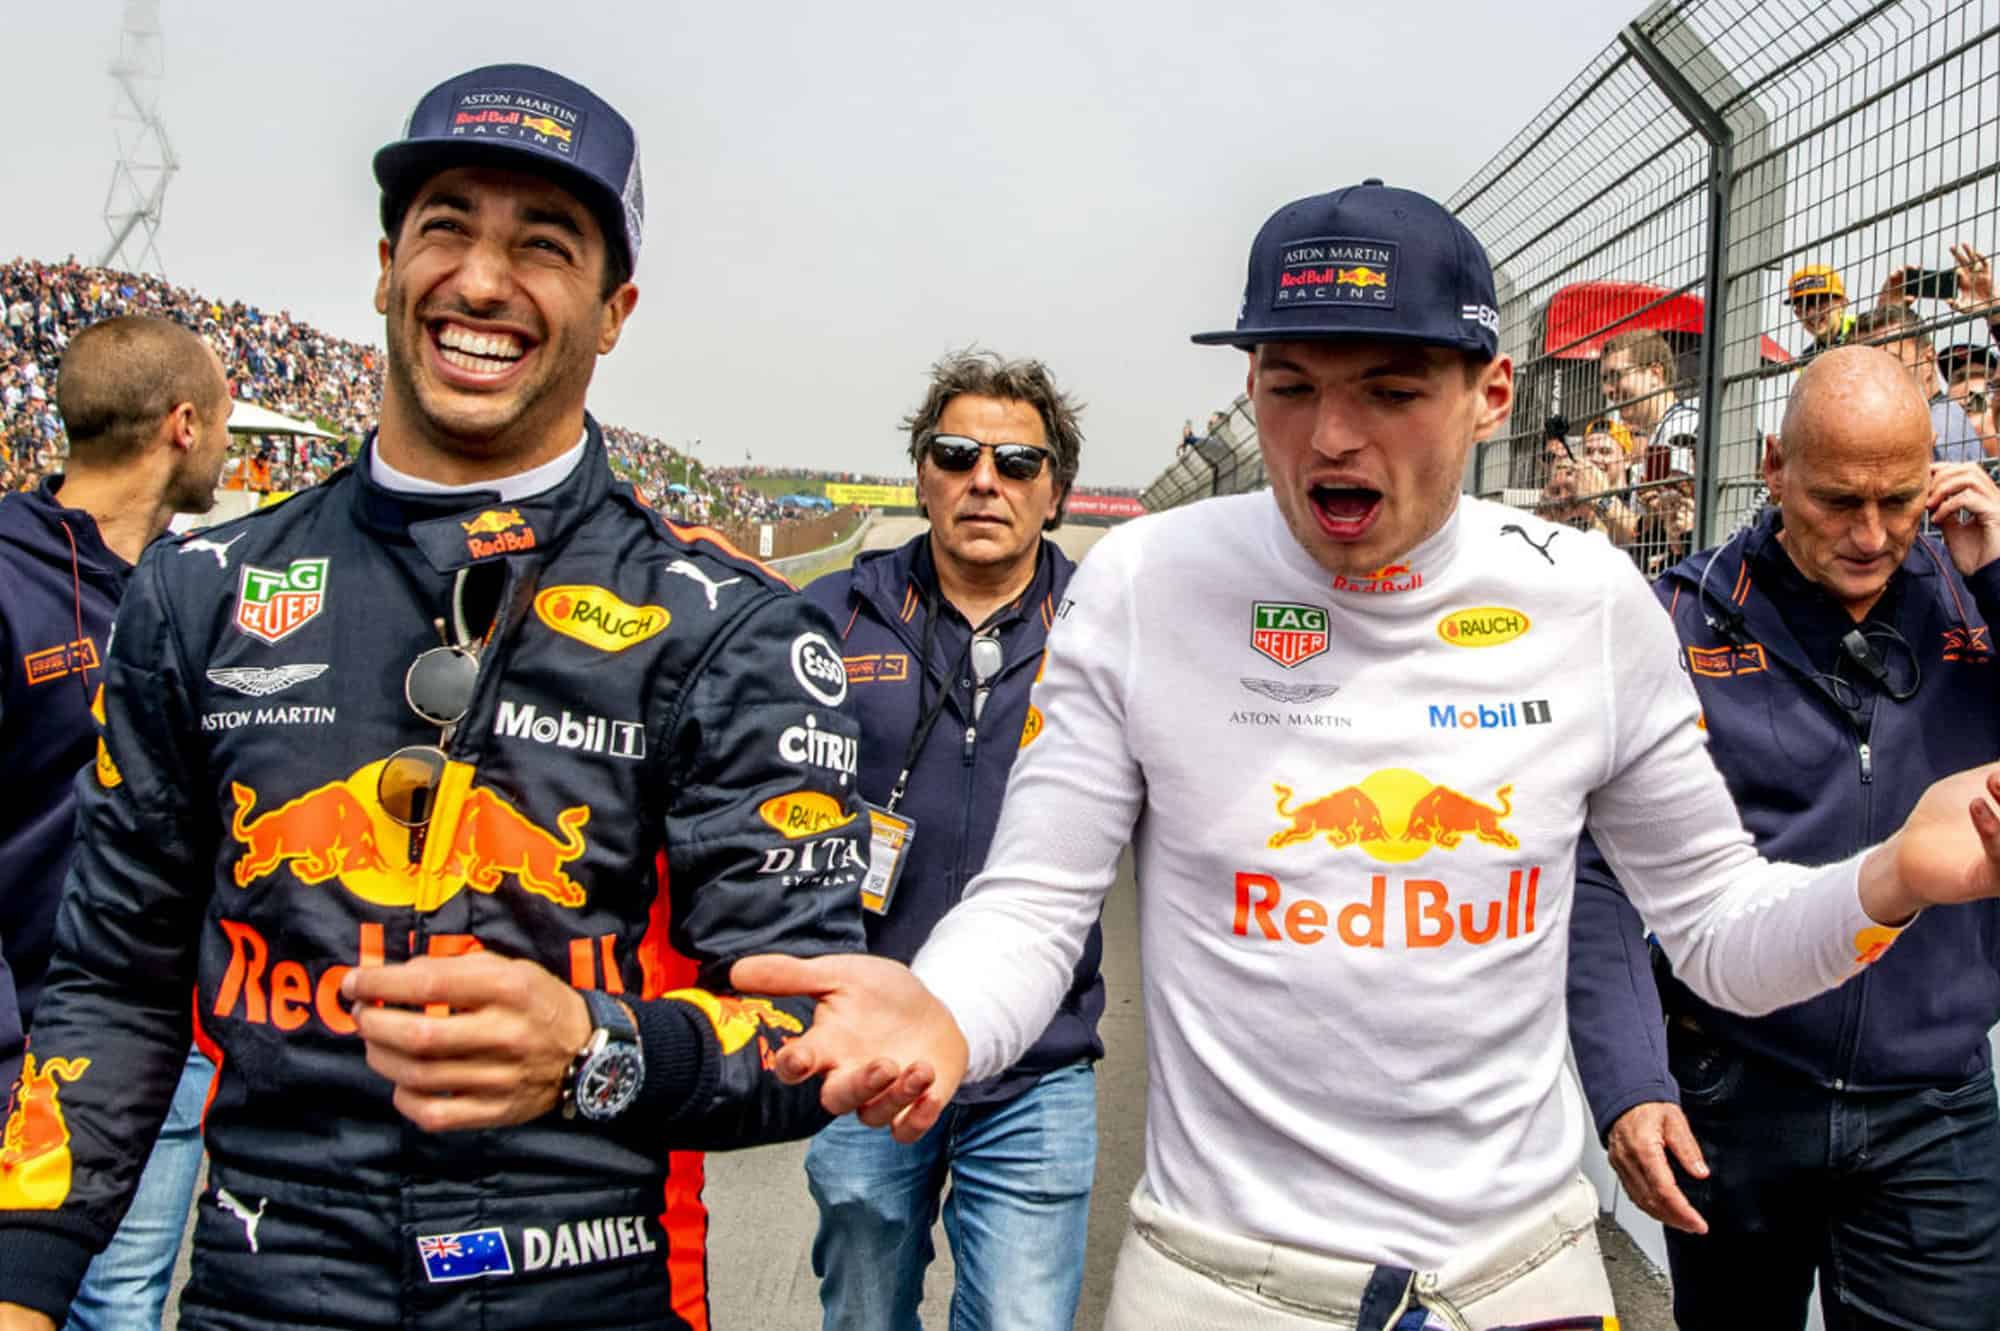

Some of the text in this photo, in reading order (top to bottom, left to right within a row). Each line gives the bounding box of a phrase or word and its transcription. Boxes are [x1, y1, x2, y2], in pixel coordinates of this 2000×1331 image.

[460, 93, 577, 123] ASTON MARTIN
[452, 125, 569, 153] RACING
[1284, 247, 1389, 262] ASTON MARTIN
[1278, 287, 1387, 300] RACING
[571, 600, 653, 638] RAUCH
[1260, 608, 1322, 629] TAG
[1459, 616, 1520, 636] RAUCH
[1257, 632, 1323, 662] HEUER
[201, 706, 336, 731] ASTON MARTIN
[494, 700, 608, 753] Mobil
[1229, 711, 1352, 728] ASTON MARTIN
[1428, 702, 1517, 730] Mobil
[757, 838, 869, 874] DITA
[1231, 866, 1541, 949] Red Bull
[522, 1215, 657, 1272] DANIEL
